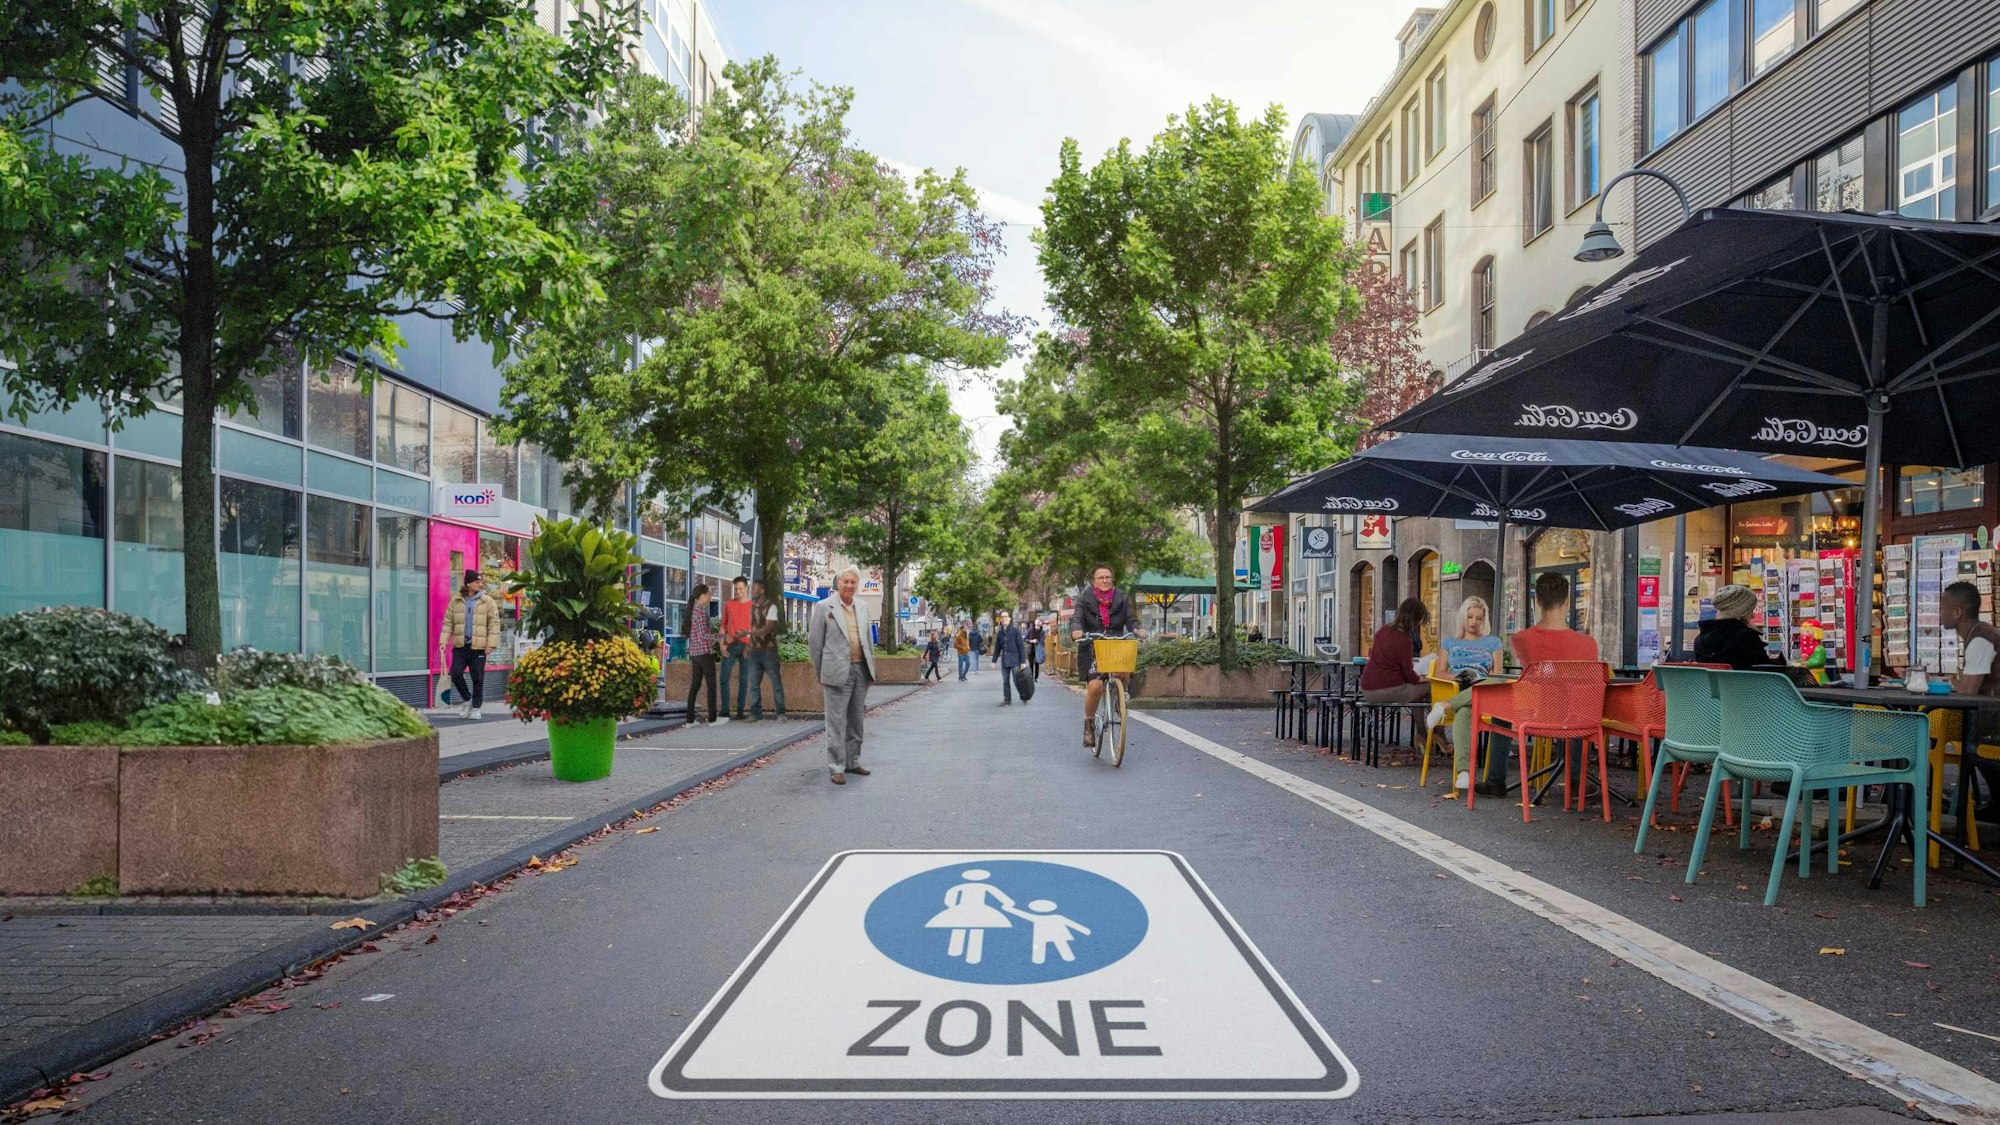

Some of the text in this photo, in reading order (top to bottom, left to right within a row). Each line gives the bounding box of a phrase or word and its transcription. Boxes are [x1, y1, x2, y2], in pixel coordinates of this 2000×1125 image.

[1451, 450, 1553, 462] Coca-Cola
[864, 580, 878, 588] dm
[846, 999, 1163, 1057] ZONE
